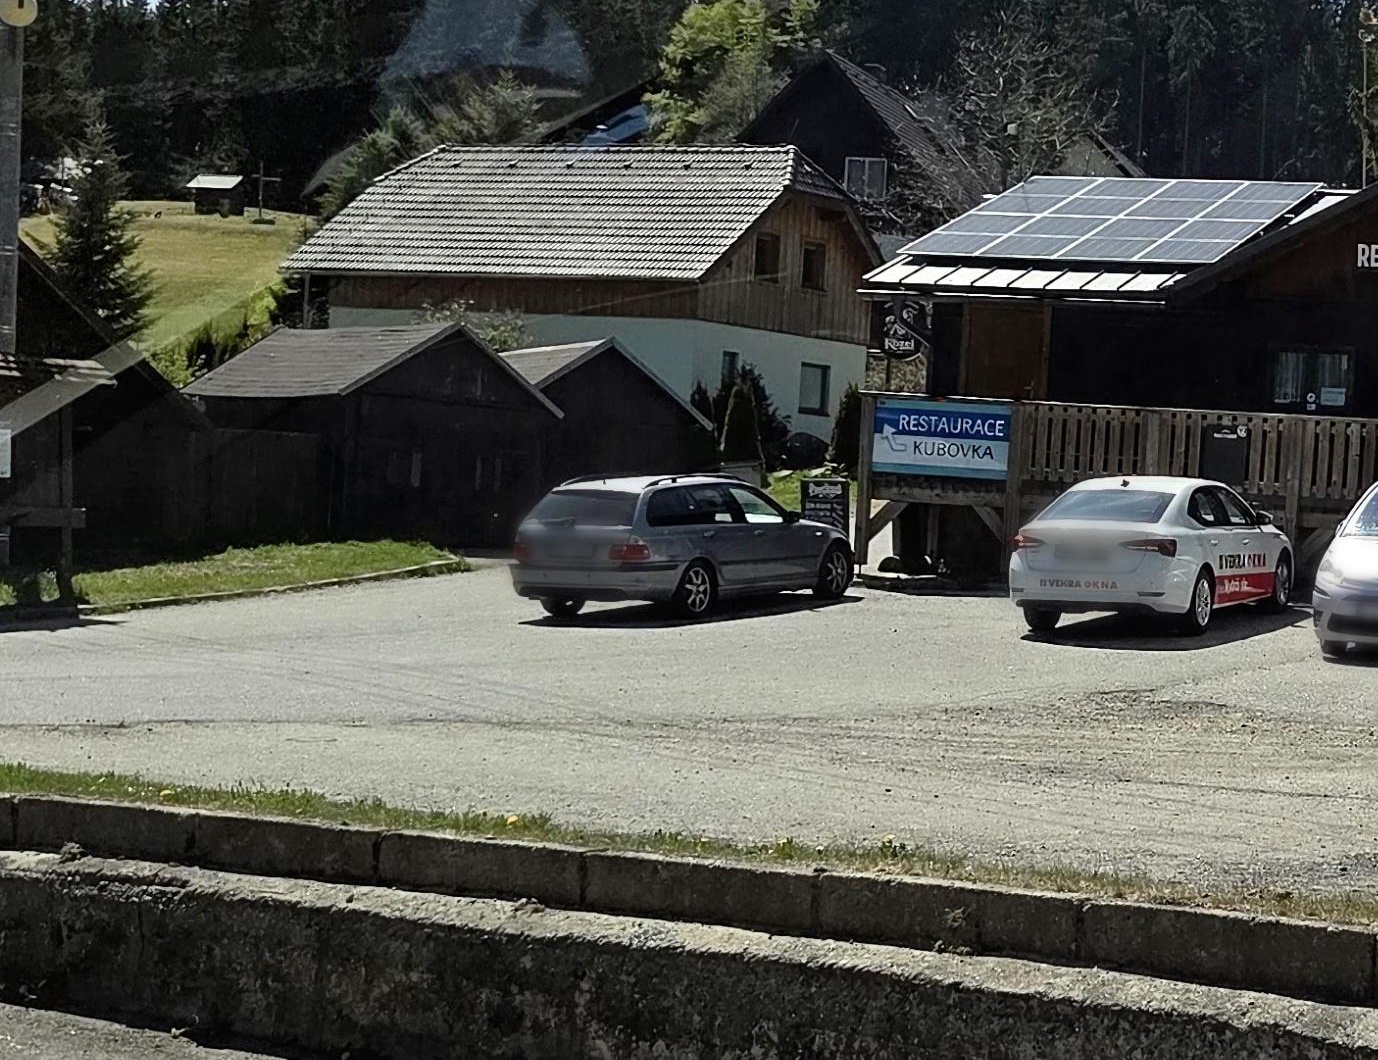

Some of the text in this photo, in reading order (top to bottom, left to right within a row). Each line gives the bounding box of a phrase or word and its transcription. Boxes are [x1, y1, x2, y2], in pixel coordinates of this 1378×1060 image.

[899, 414, 1005, 436] RESTAURACE
[913, 440, 994, 460] KUBOVKA
[1048, 579, 1118, 590] VEKRA OKNA
